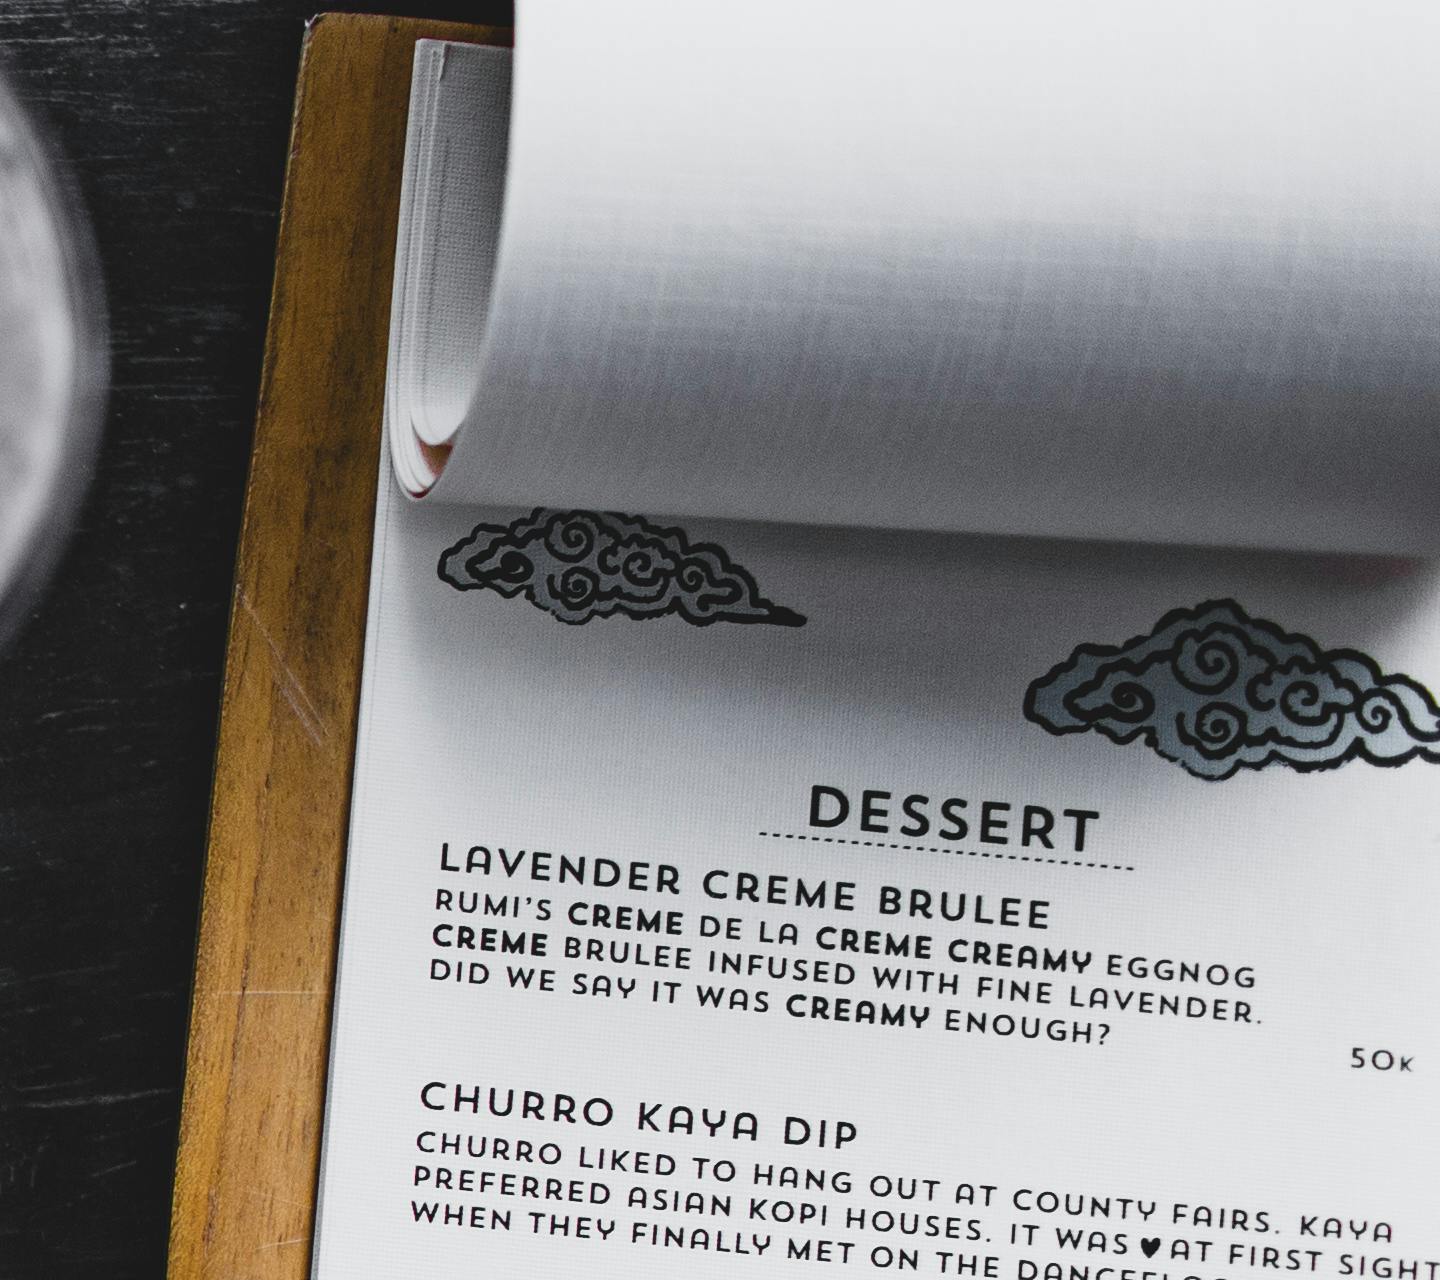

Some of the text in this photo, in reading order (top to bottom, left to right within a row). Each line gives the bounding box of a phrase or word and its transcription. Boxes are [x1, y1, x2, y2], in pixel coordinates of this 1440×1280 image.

[808, 784, 1100, 853] DESSERT
[440, 842, 1050, 930] LAVENDER CREME BRULEE
[432, 923, 1263, 1025] CREME BRULEE INFUSED WITH FINE LAVENDER.
[435, 888, 1255, 989] RUMI'S CREME DE LA CREME CREAMY EGGNOG
[429, 958, 1111, 1046] DID WE SAY IT WAS CREAMY ENOUGH?
[420, 1081, 857, 1150] CHURRO KAYA DIP
[413, 1165, 611, 1205] PREFERRED
[627, 1186, 731, 1217] ASIAN
[749, 1197, 827, 1227] KOPI
[845, 1207, 992, 1242] HOUSES.
[1010, 1223, 1041, 1246] IT
[1055, 1227, 1128, 1255] WAS
[1170, 1238, 1214, 1262] AT
[1229, 1243, 1323, 1272] FIRST
[416, 1130, 1392, 1244] CHURRO LIKED TO HANG OUT AT COUNTY FAIRS. KAYA
[411, 1200, 512, 1231] WHEN
[527, 1211, 616, 1241] THEY
[631, 1222, 771, 1256] FINALLY
[787, 1237, 856, 1264] MET
[870, 1245, 919, 1271] ON
[935, 1251, 1000, 1279] THE
